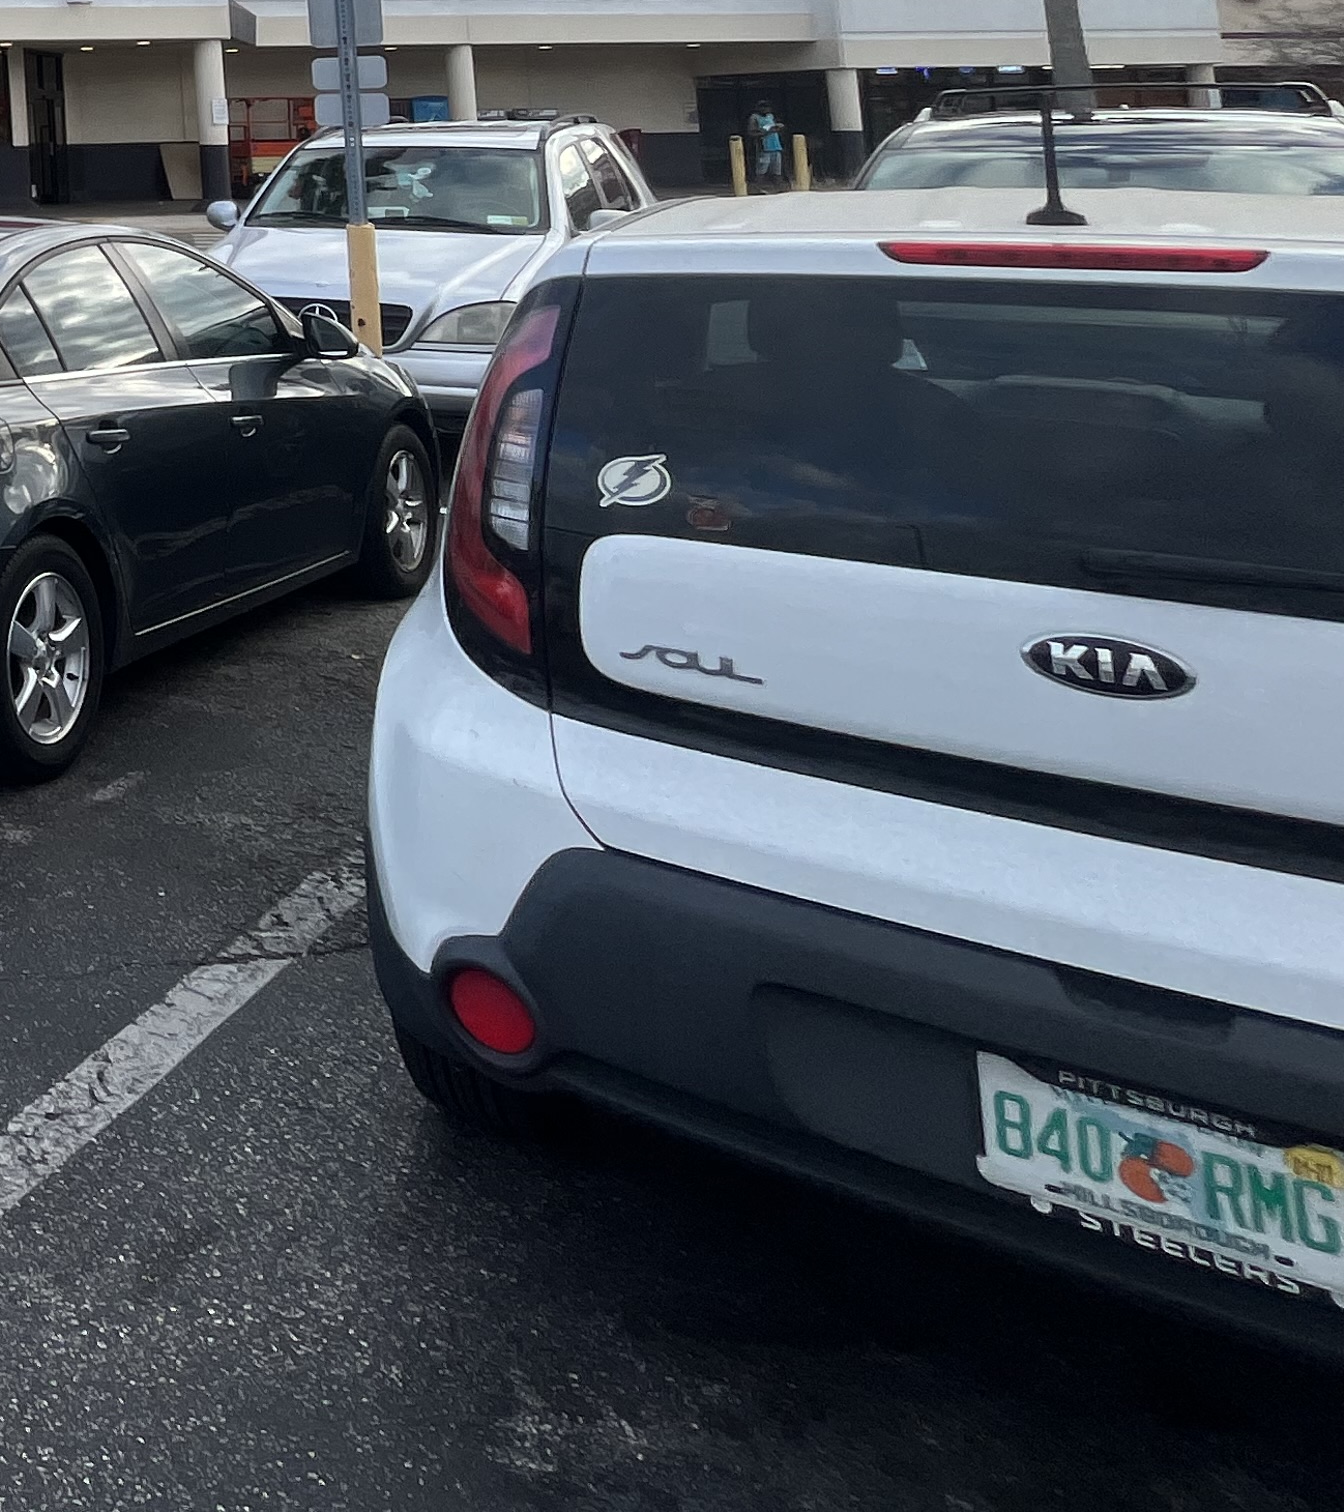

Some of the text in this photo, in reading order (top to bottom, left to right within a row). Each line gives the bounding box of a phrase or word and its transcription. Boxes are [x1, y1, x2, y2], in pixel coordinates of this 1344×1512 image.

[1045, 639, 1169, 692] KIA
[1058, 1070, 1257, 1139] PITTSBURGH
[993, 1089, 1343, 1256] 840 RMG
[1079, 1209, 1301, 1294] STEELERS
